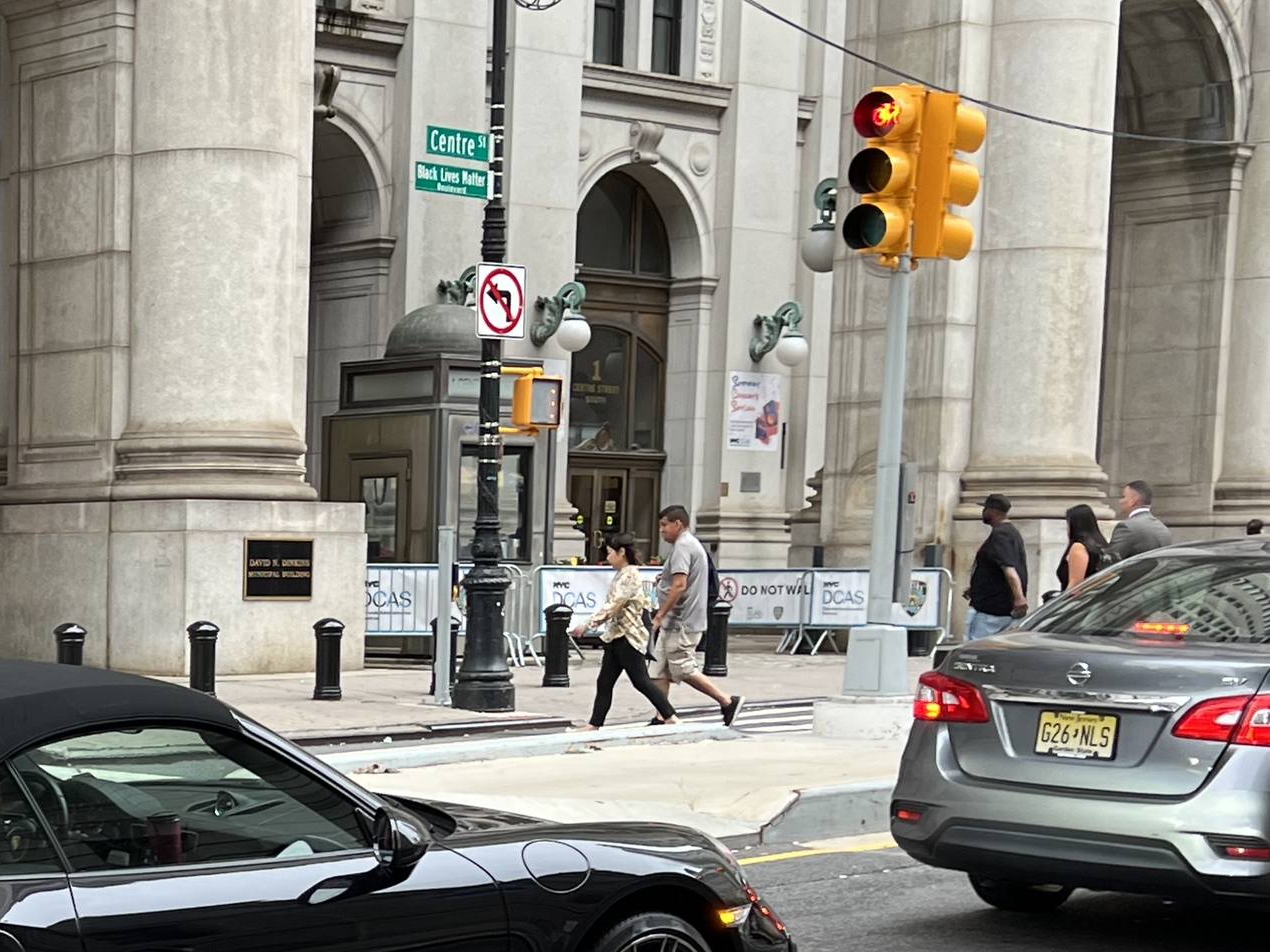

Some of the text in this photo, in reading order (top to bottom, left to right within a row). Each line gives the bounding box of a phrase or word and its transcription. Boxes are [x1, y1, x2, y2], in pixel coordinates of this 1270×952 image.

[431, 130, 486, 156] Centre St
[417, 164, 485, 187] Black Lives Matter
[437, 182, 467, 195] Boulevard
[592, 360, 602, 381] 1
[249, 559, 271, 567] DAVID
[553, 581, 570, 589] NYC
[741, 584, 812, 596] DO NOT WAL
[552, 591, 596, 609] DCAS
[822, 590, 865, 605] DCAS
[1041, 722, 1111, 748] G26 NLS
